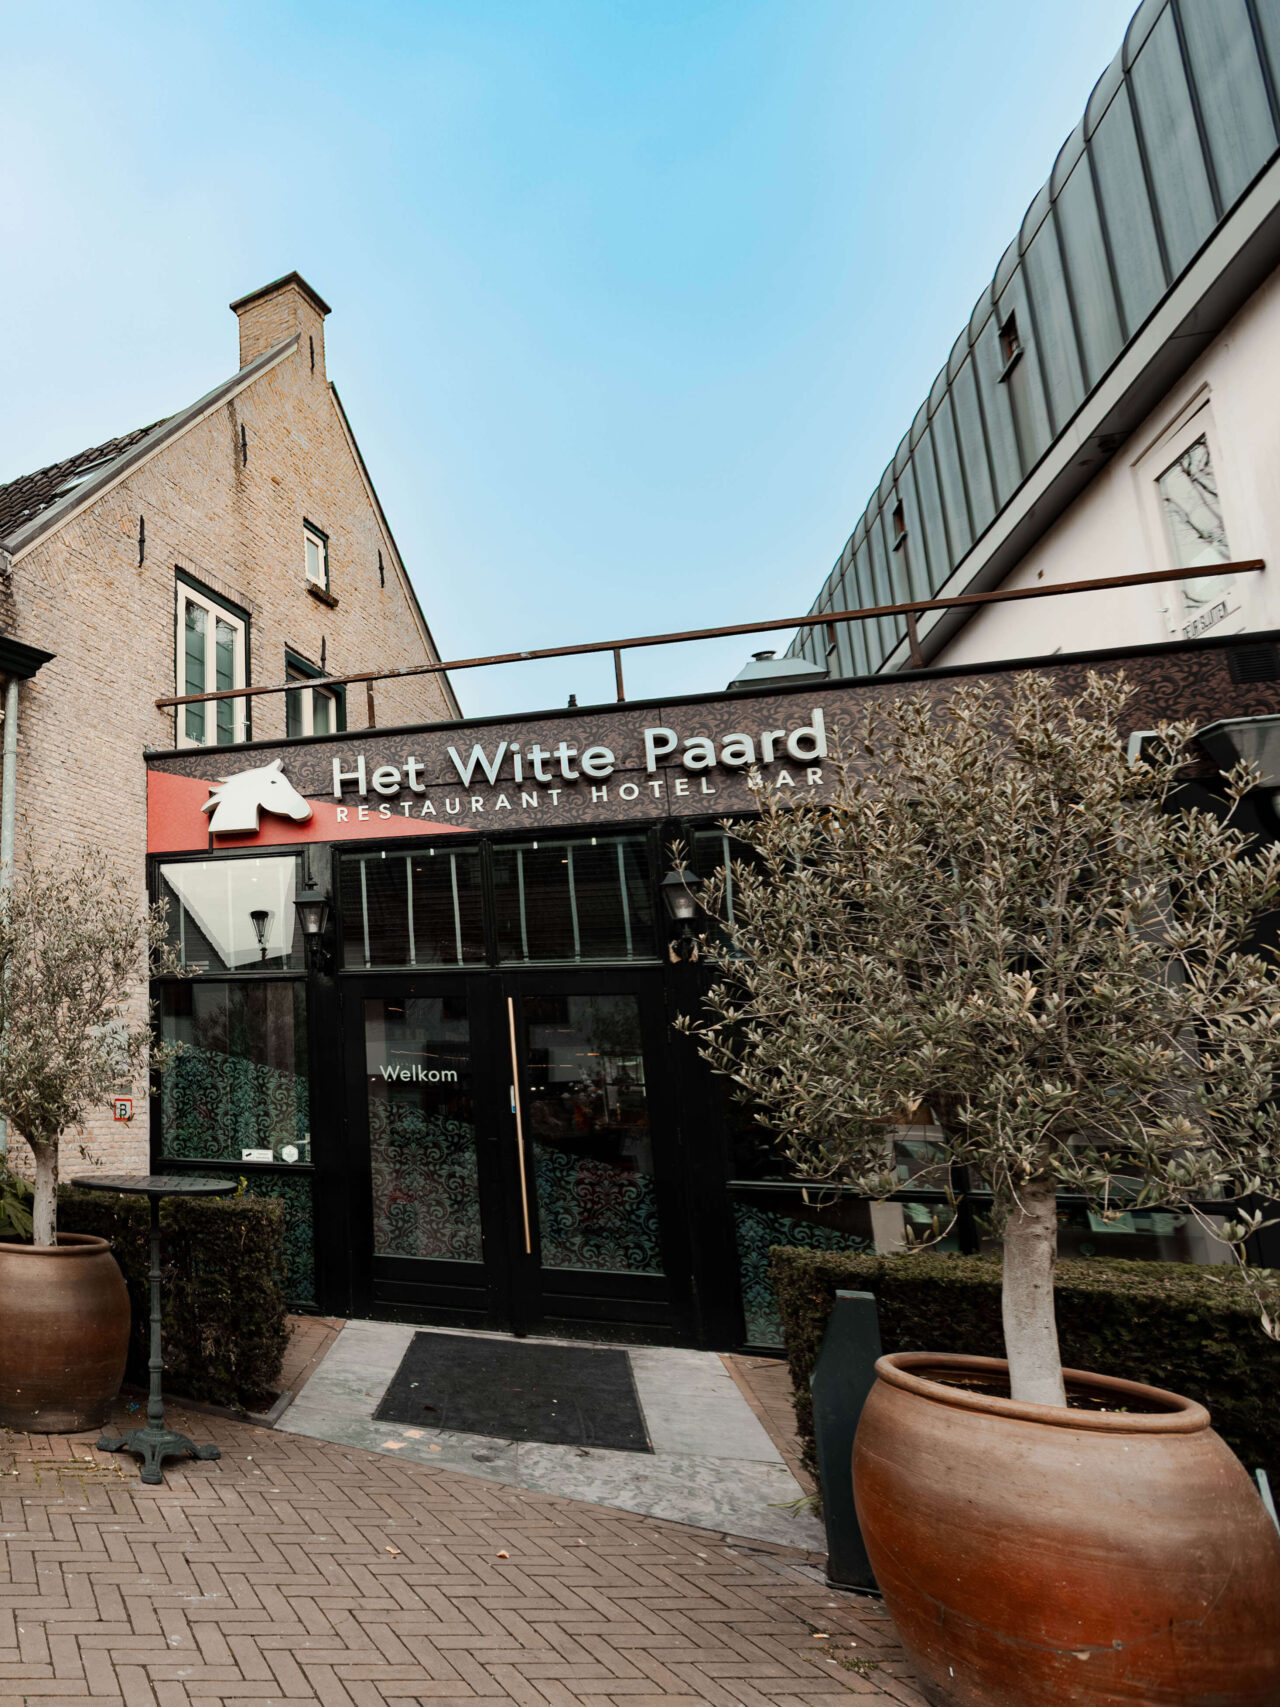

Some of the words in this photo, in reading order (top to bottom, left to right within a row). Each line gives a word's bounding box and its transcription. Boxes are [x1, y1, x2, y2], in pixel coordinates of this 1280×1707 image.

[332, 754, 427, 799] Het
[447, 741, 615, 789] Witte
[644, 708, 828, 774] Paard
[336, 789, 563, 823] RESTAURANT
[591, 777, 716, 802] HOTEL
[380, 1064, 458, 1082] Welkom
